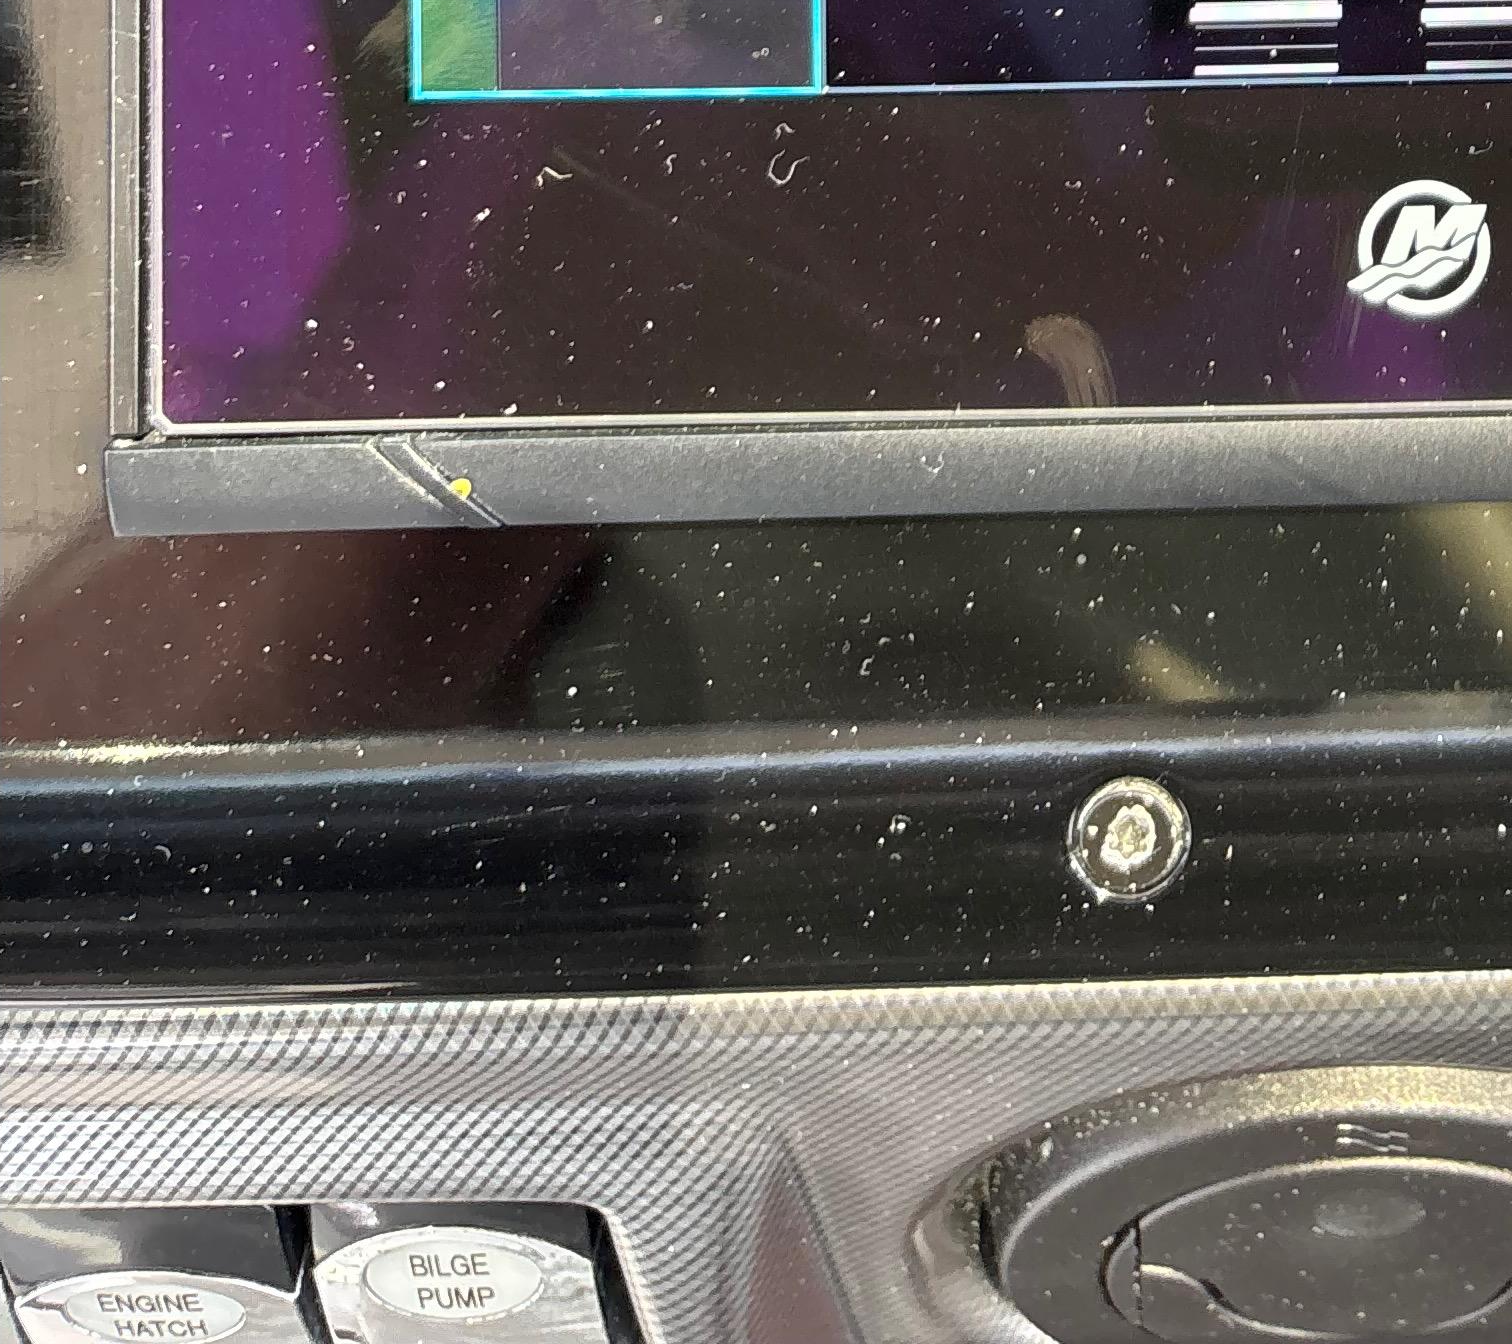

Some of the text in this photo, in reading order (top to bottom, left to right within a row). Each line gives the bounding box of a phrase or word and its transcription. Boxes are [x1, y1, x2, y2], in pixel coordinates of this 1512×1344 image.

[408, 1253, 489, 1278] BILGE
[96, 1292, 205, 1314] ENGINE
[417, 1287, 496, 1310] PUMP
[114, 1319, 209, 1339] HATCH
